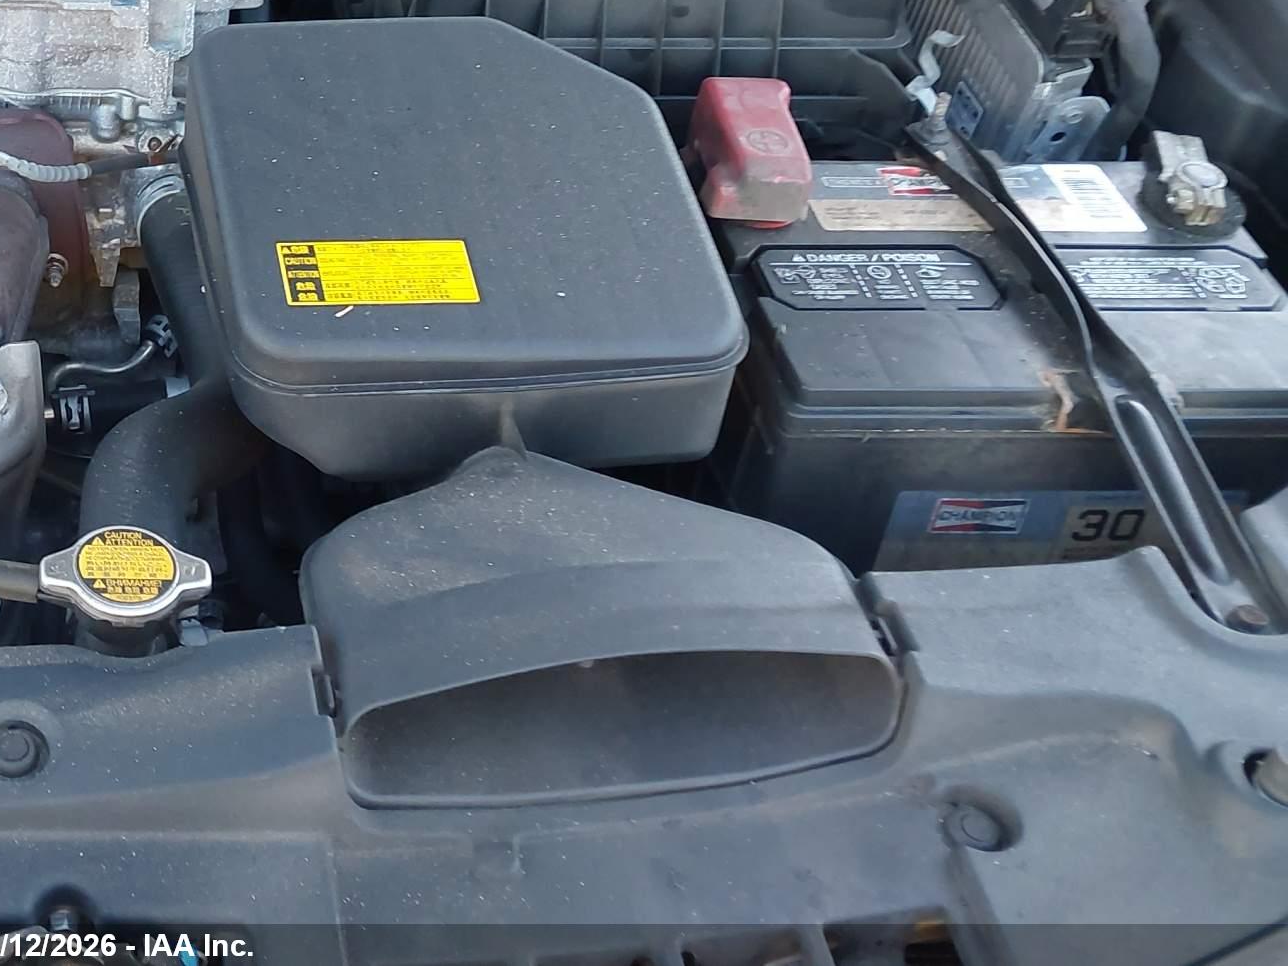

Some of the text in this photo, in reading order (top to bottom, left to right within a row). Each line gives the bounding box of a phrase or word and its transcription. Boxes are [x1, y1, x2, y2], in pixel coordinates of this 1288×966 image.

[805, 253, 870, 263] DANGER
[882, 253, 941, 262] POISON
[1071, 508, 1146, 542] 30
